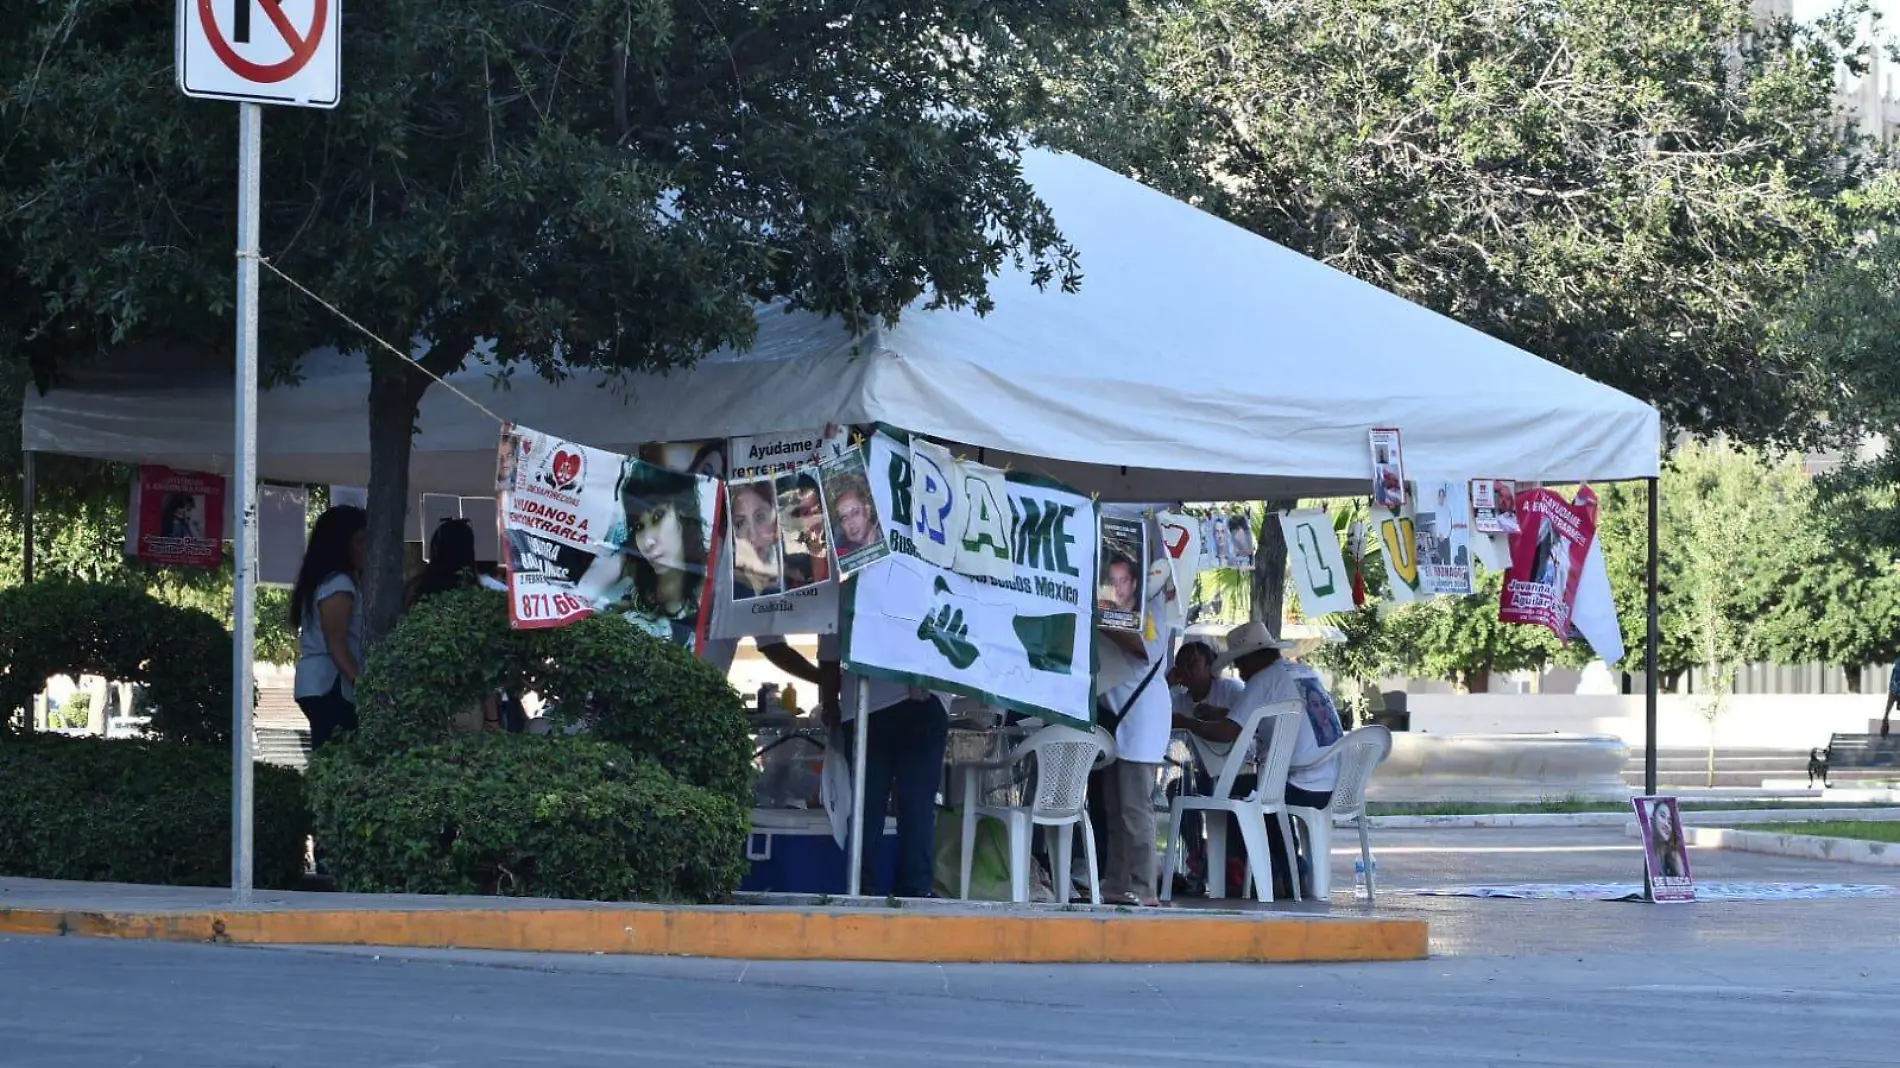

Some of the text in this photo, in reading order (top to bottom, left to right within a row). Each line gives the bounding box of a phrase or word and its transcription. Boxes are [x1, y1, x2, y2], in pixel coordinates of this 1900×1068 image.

[748, 440, 813, 460] Ayúdame
[578, 519, 589, 531] A
[962, 475, 1010, 560] A
[522, 593, 550, 618] 871
